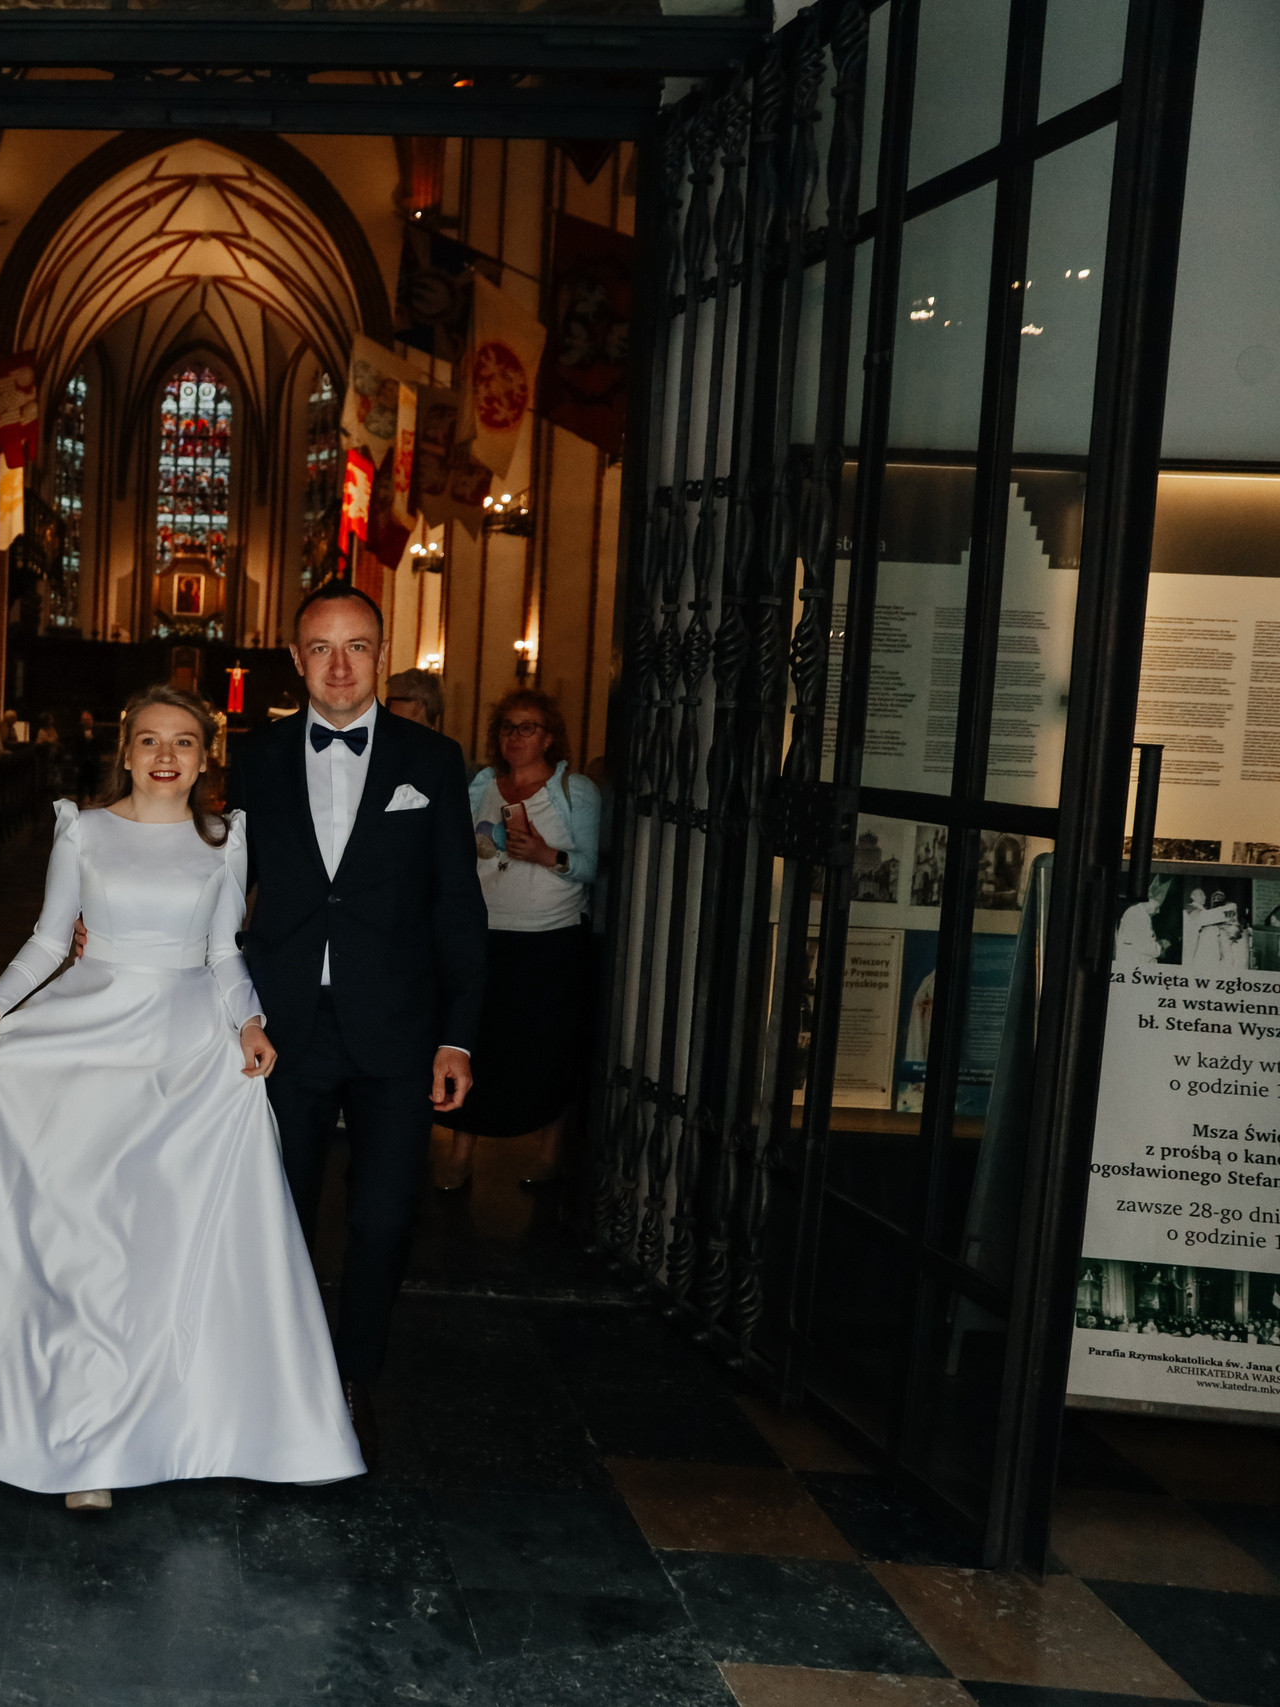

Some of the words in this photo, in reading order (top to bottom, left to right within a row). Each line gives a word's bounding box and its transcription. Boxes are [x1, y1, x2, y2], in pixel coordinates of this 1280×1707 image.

[850, 957, 890, 968] Wieczory
[844, 979, 890, 991] zyńskiego
[1131, 966, 1189, 990] Święta
[1195, 978, 1211, 989] w
[1158, 997, 1176, 1009] za
[1138, 1014, 1159, 1029] bł.
[1166, 1017, 1232, 1035] Stefana
[1174, 1054, 1191, 1066] w
[1197, 1051, 1253, 1075] każdy
[1169, 1079, 1181, 1091] o
[1187, 1078, 1269, 1097] godzinie
[1192, 1123, 1238, 1140] Msza
[1145, 1145, 1155, 1156] z
[1160, 1145, 1222, 1165] prośbą
[1227, 1151, 1238, 1162] o
[1090, 1162, 1221, 1186] ogosławionego
[1116, 1199, 1183, 1216] zawsze
[1189, 1201, 1243, 1224] 28-go
[1167, 1228, 1178, 1241] o
[1185, 1228, 1266, 1248] godzinie
[1088, 1346, 1126, 1358] Parafia
[1128, 1350, 1223, 1367] Rzymskokatolicka
[1225, 1358, 1243, 1369] św.
[1246, 1361, 1273, 1372] Jana
[1166, 1365, 1249, 1381] ARCHIKATEDRA
